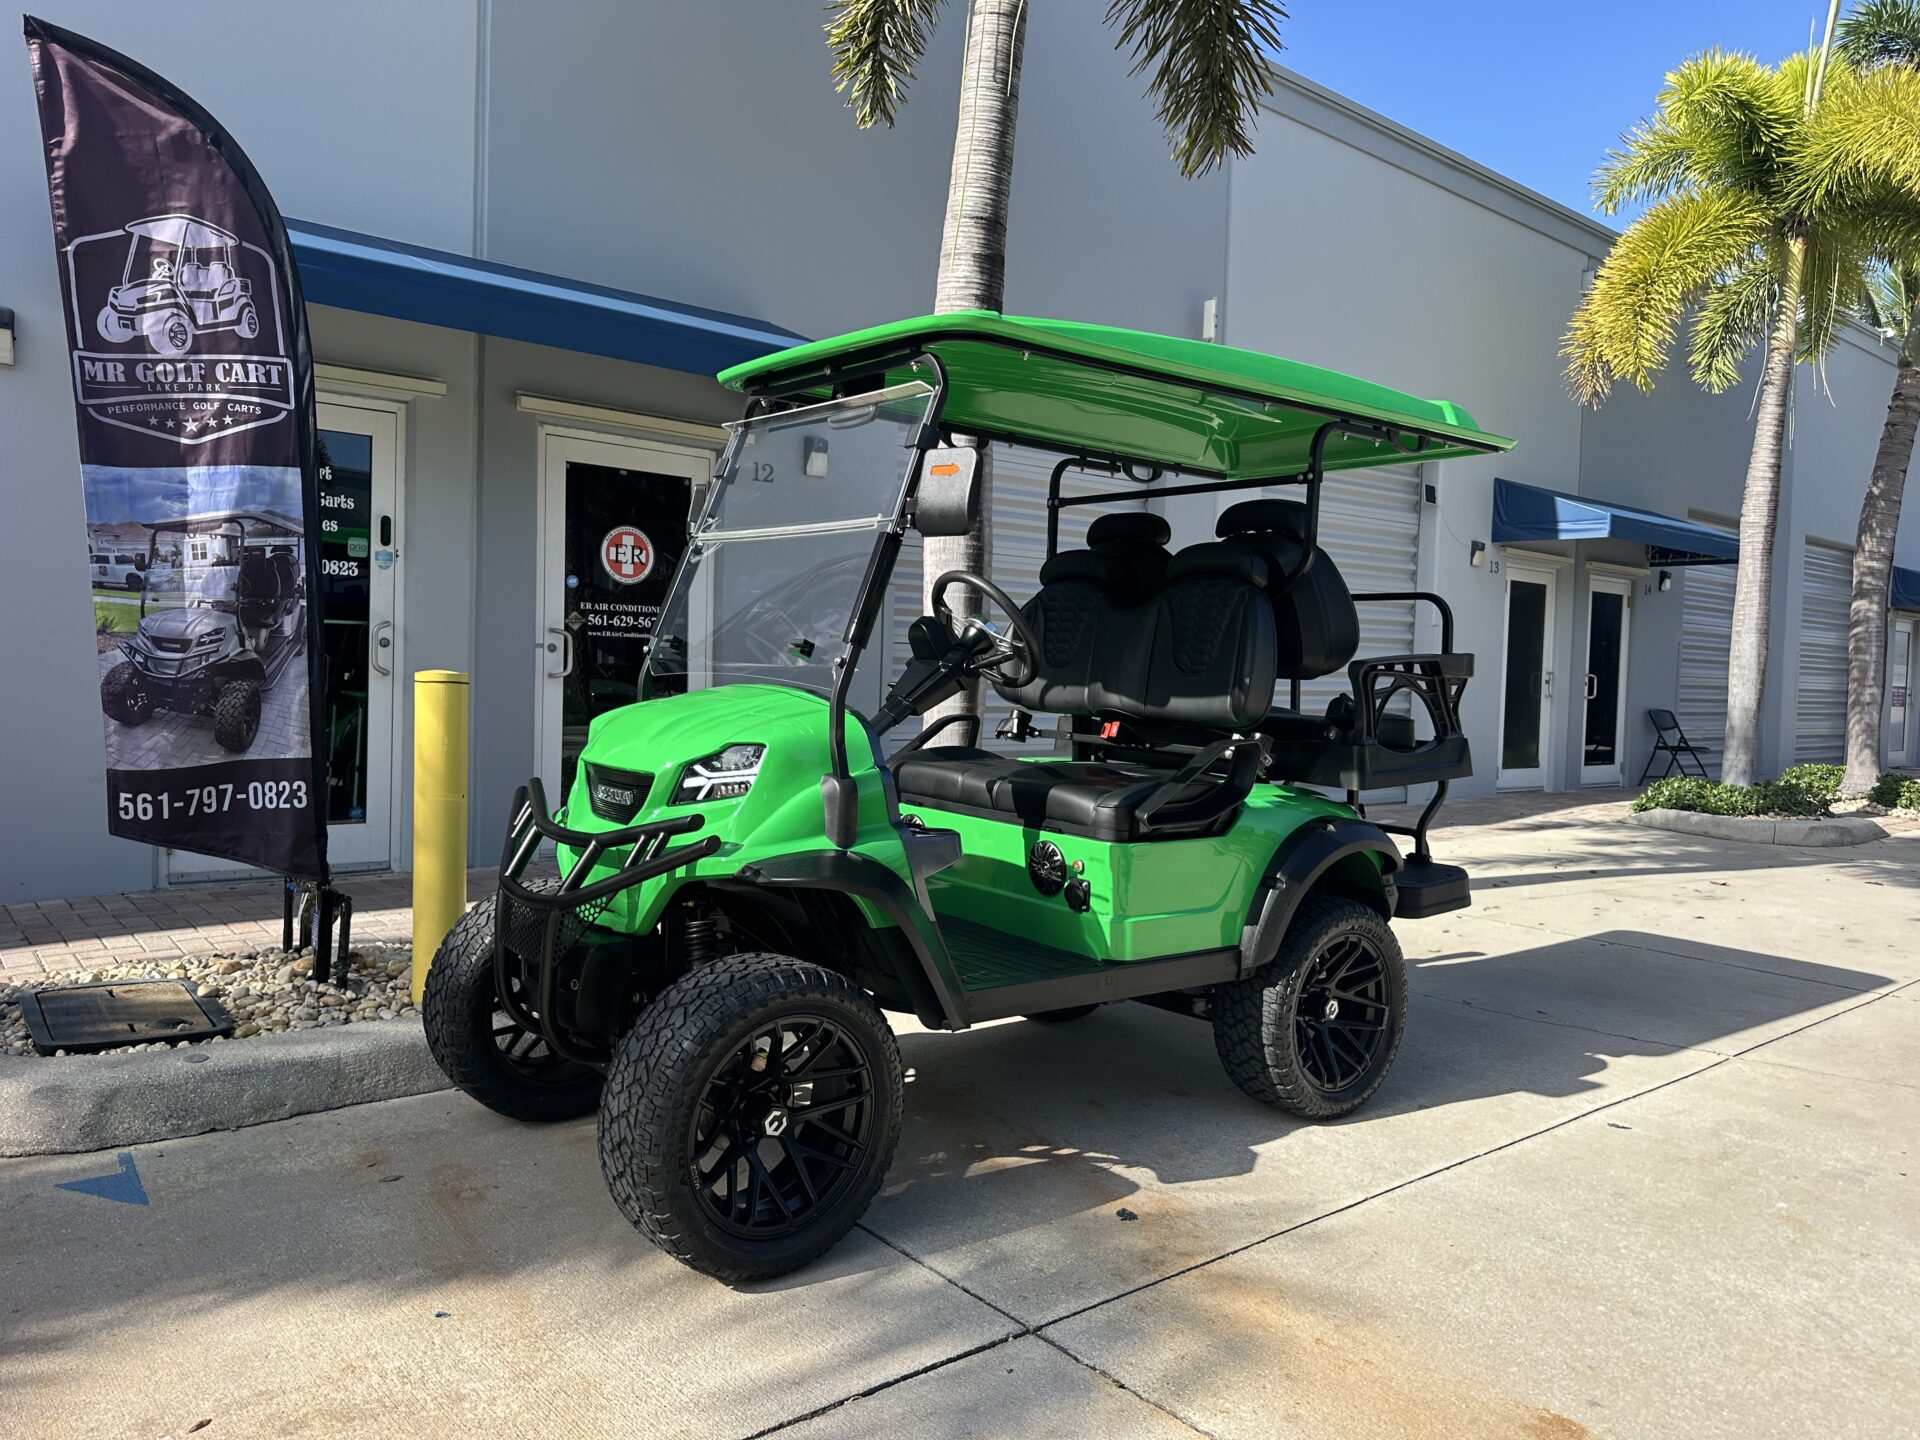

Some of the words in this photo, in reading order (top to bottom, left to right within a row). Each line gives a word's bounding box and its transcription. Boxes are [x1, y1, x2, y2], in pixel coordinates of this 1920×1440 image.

[83, 360, 126, 383] MR
[135, 362, 206, 383] GOLF
[215, 362, 283, 385] CART
[147, 383, 180, 392] LAKE
[188, 383, 222, 392] PARK
[108, 402, 186, 415] PERFORMANCE
[193, 402, 220, 410] GOLF
[227, 403, 262, 415] CARTS
[752, 462, 774, 483] 12
[614, 543, 647, 566] ER
[1490, 560, 1499, 574] 13
[580, 602, 592, 610] ER
[593, 603, 609, 611] AIR
[610, 604, 660, 613] CONDITIONI
[118, 780, 308, 821] 561-797-0823
